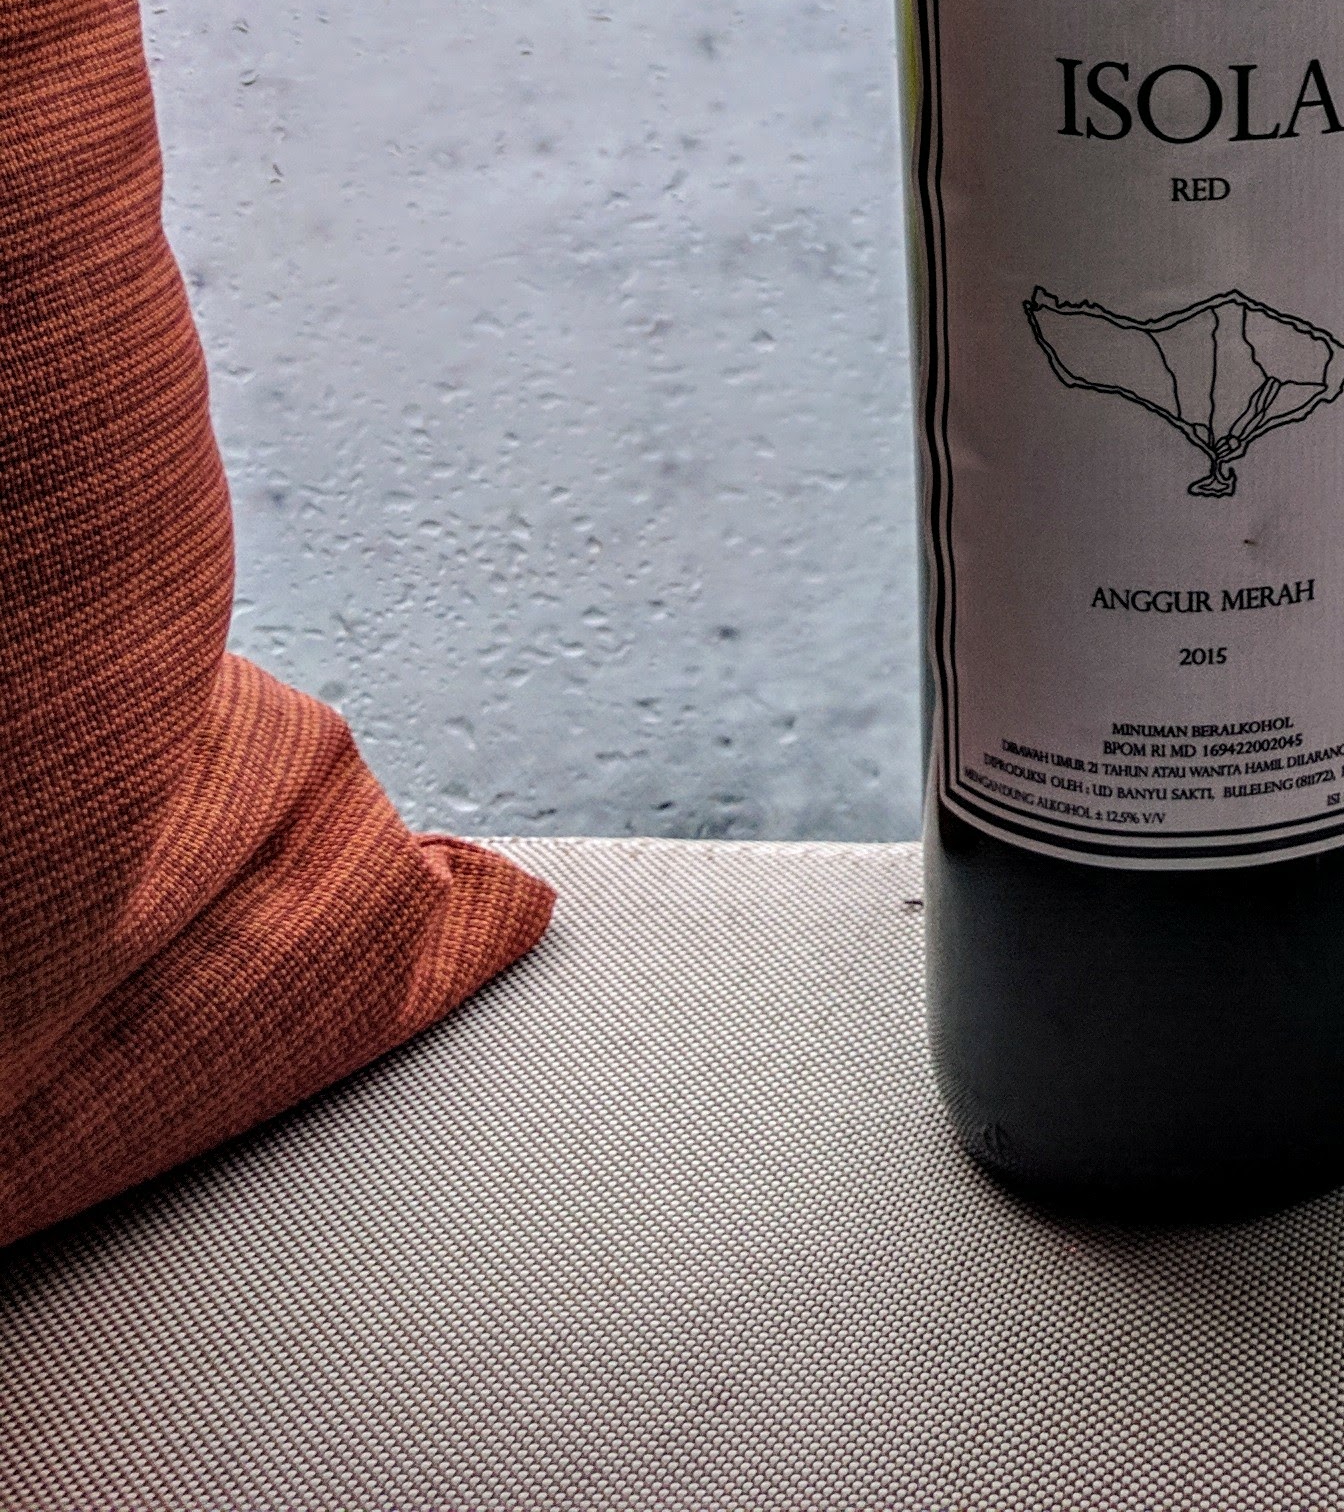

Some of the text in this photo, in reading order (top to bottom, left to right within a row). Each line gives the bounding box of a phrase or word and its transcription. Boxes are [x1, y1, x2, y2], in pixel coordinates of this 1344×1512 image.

[1171, 177, 1231, 201] RED
[1091, 579, 1315, 613] ANGGUR MERAH
[1179, 647, 1227, 665] 2015
[1112, 716, 1294, 738] MINUMAN BERALKOHOL
[1002, 738, 1049, 764] DIBAWAH
[1051, 753, 1085, 772] UMUR
[1088, 761, 1099, 774] 21
[1103, 763, 1149, 778] TAHUN
[1151, 766, 1186, 778] ATAU
[1189, 764, 1242, 778] WANITA
[1245, 757, 1284, 774] HAMIL
[1103, 733, 1303, 758] BPOM RI MD 169422002045
[983, 752, 1047, 785] DIPRODUKSI
[1050, 775, 1083, 793] OLEH
[1092, 783, 1113, 797] UD
[1117, 787, 1167, 800] BANYU
[1171, 788, 1215, 801] SAKTI,
[1223, 778, 1293, 799] BULELENG
[964, 767, 1034, 806] MENGANDUNG
[1037, 796, 1093, 820] ALKOHOL
[1142, 812, 1166, 824] V/V
[1326, 792, 1341, 807] ISI
